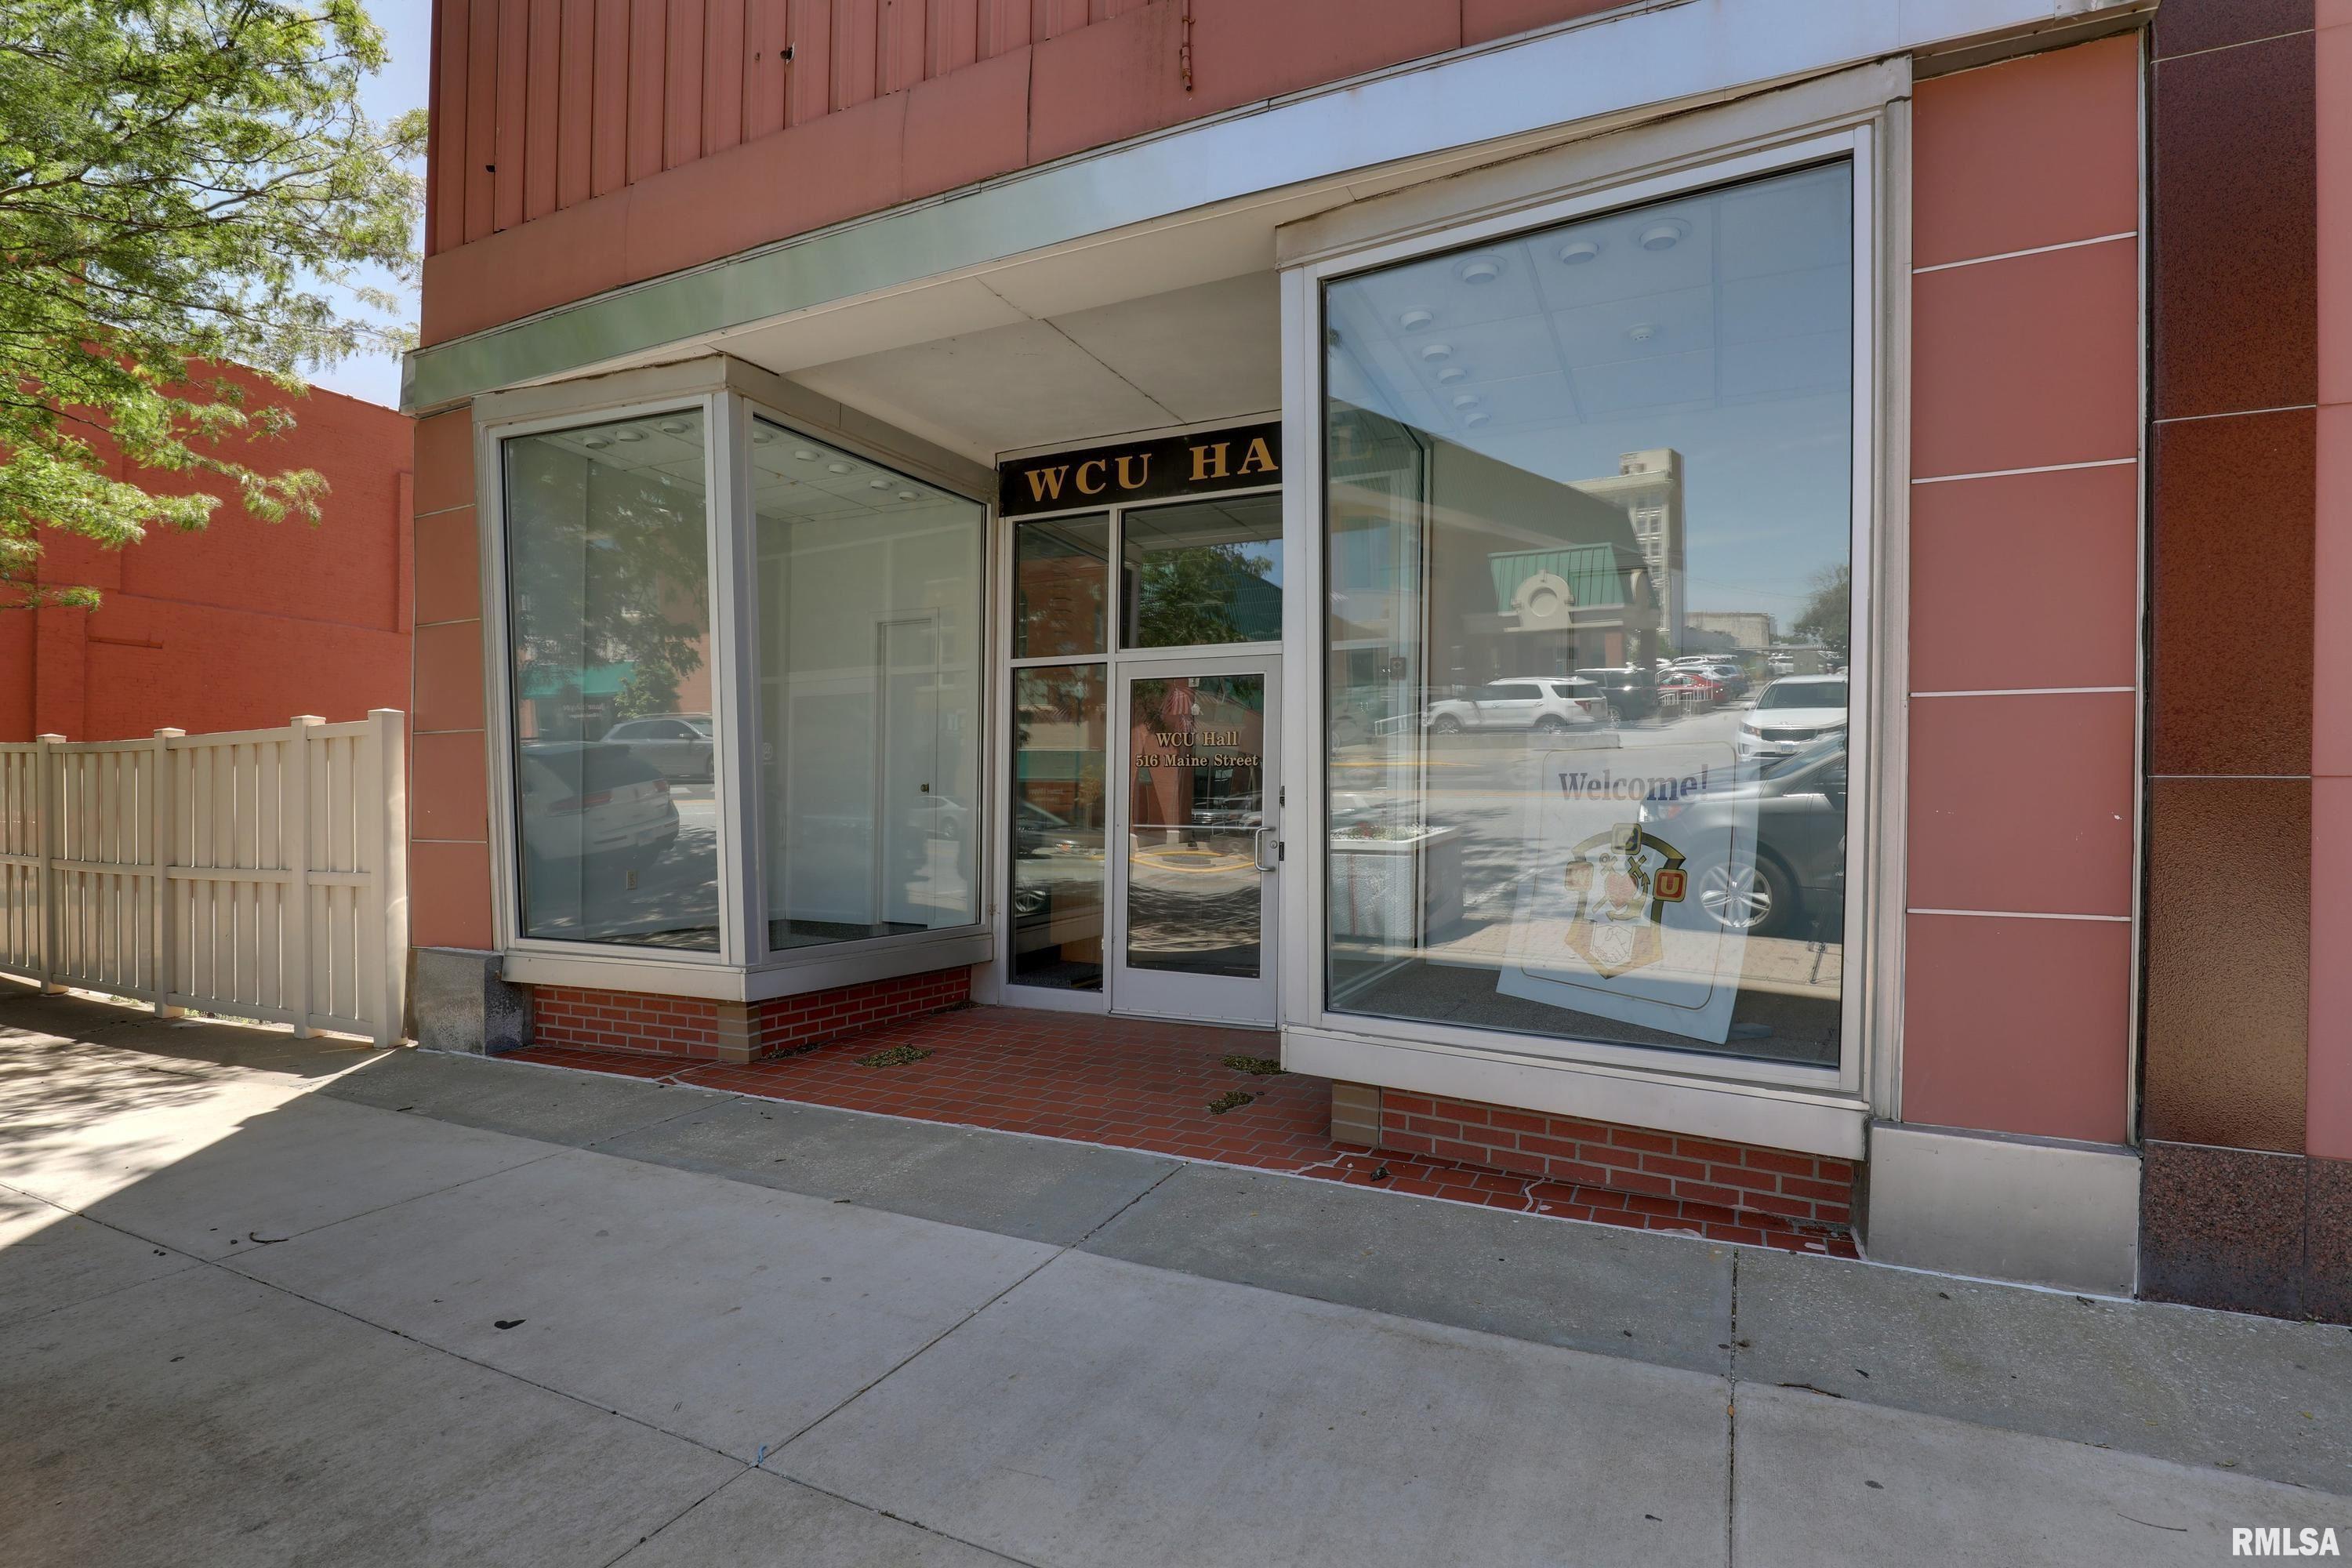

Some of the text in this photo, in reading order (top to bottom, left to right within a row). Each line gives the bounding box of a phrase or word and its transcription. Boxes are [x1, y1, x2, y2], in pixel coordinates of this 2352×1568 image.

[1025, 453, 1152, 502] WCU
[1189, 437, 1279, 481] HA
[1156, 731, 1240, 747] WCU Hall
[1135, 753, 1259, 768] 516 Maine Street
[1558, 764, 1709, 802] Welcome!
[1661, 876, 1680, 895] U
